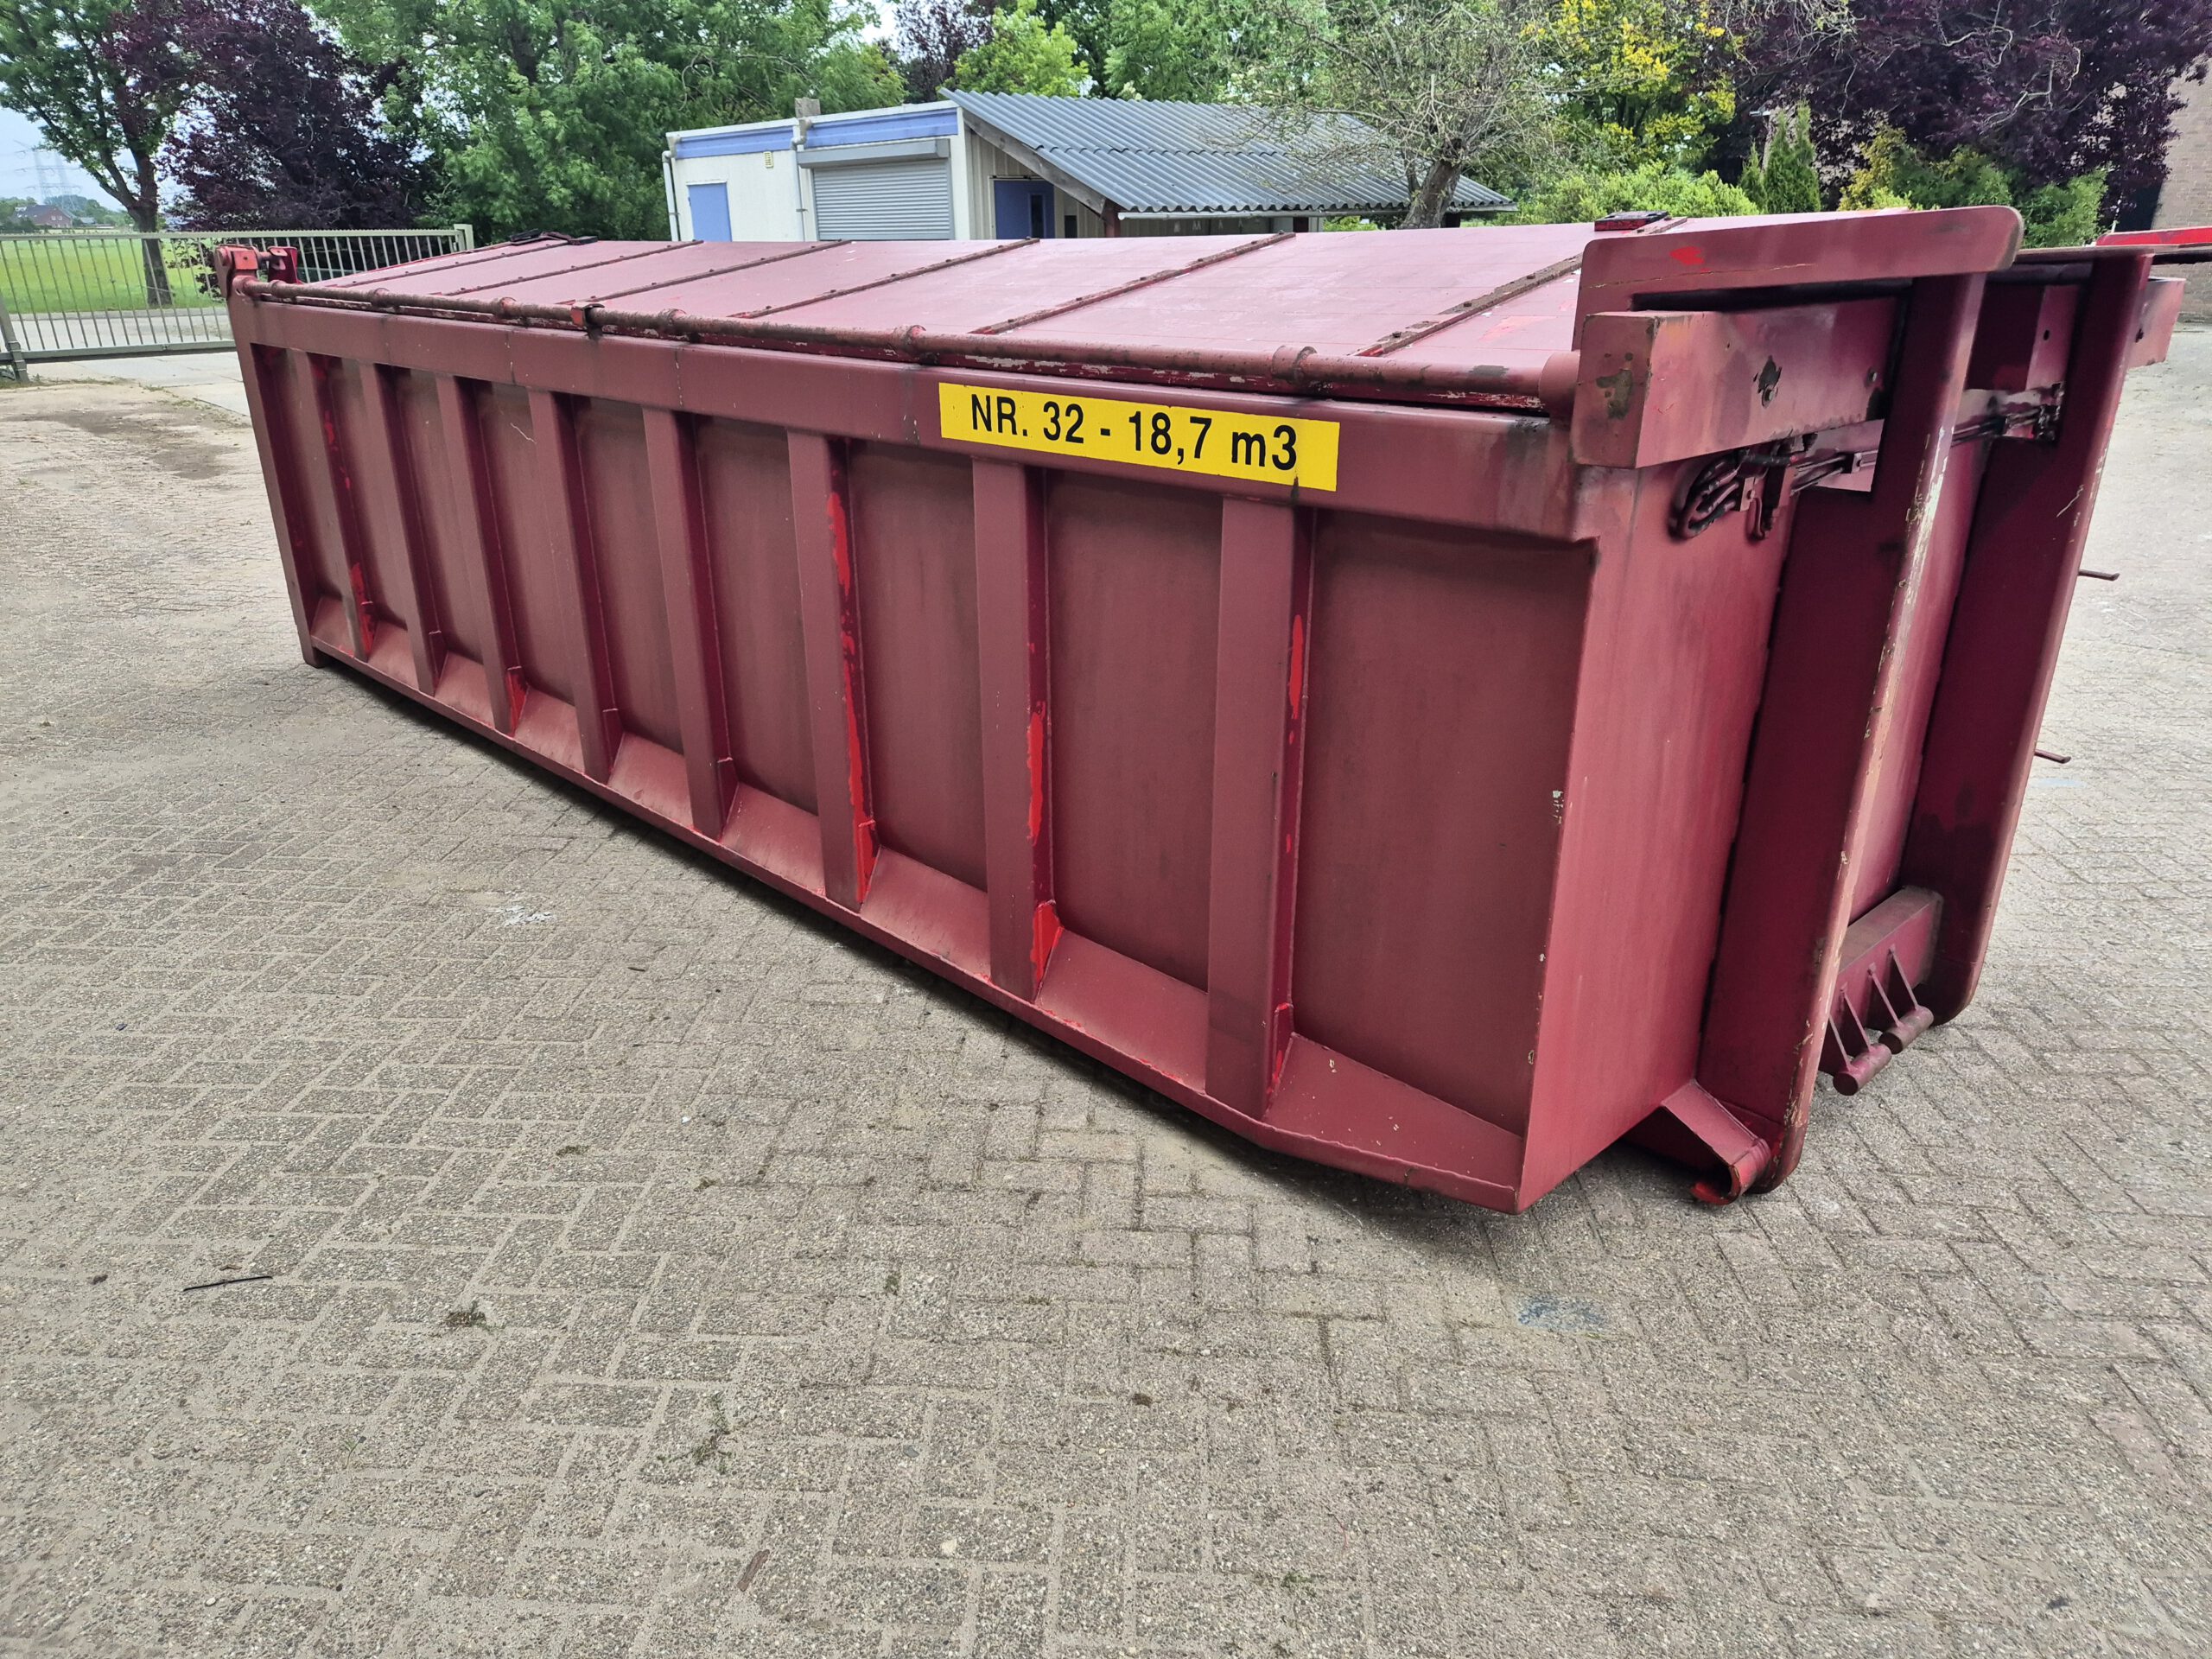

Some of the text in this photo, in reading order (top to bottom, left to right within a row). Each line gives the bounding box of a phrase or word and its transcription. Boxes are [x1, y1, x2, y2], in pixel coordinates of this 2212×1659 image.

[971, 393, 1297, 471] NR. 32 - 18,7 m3
